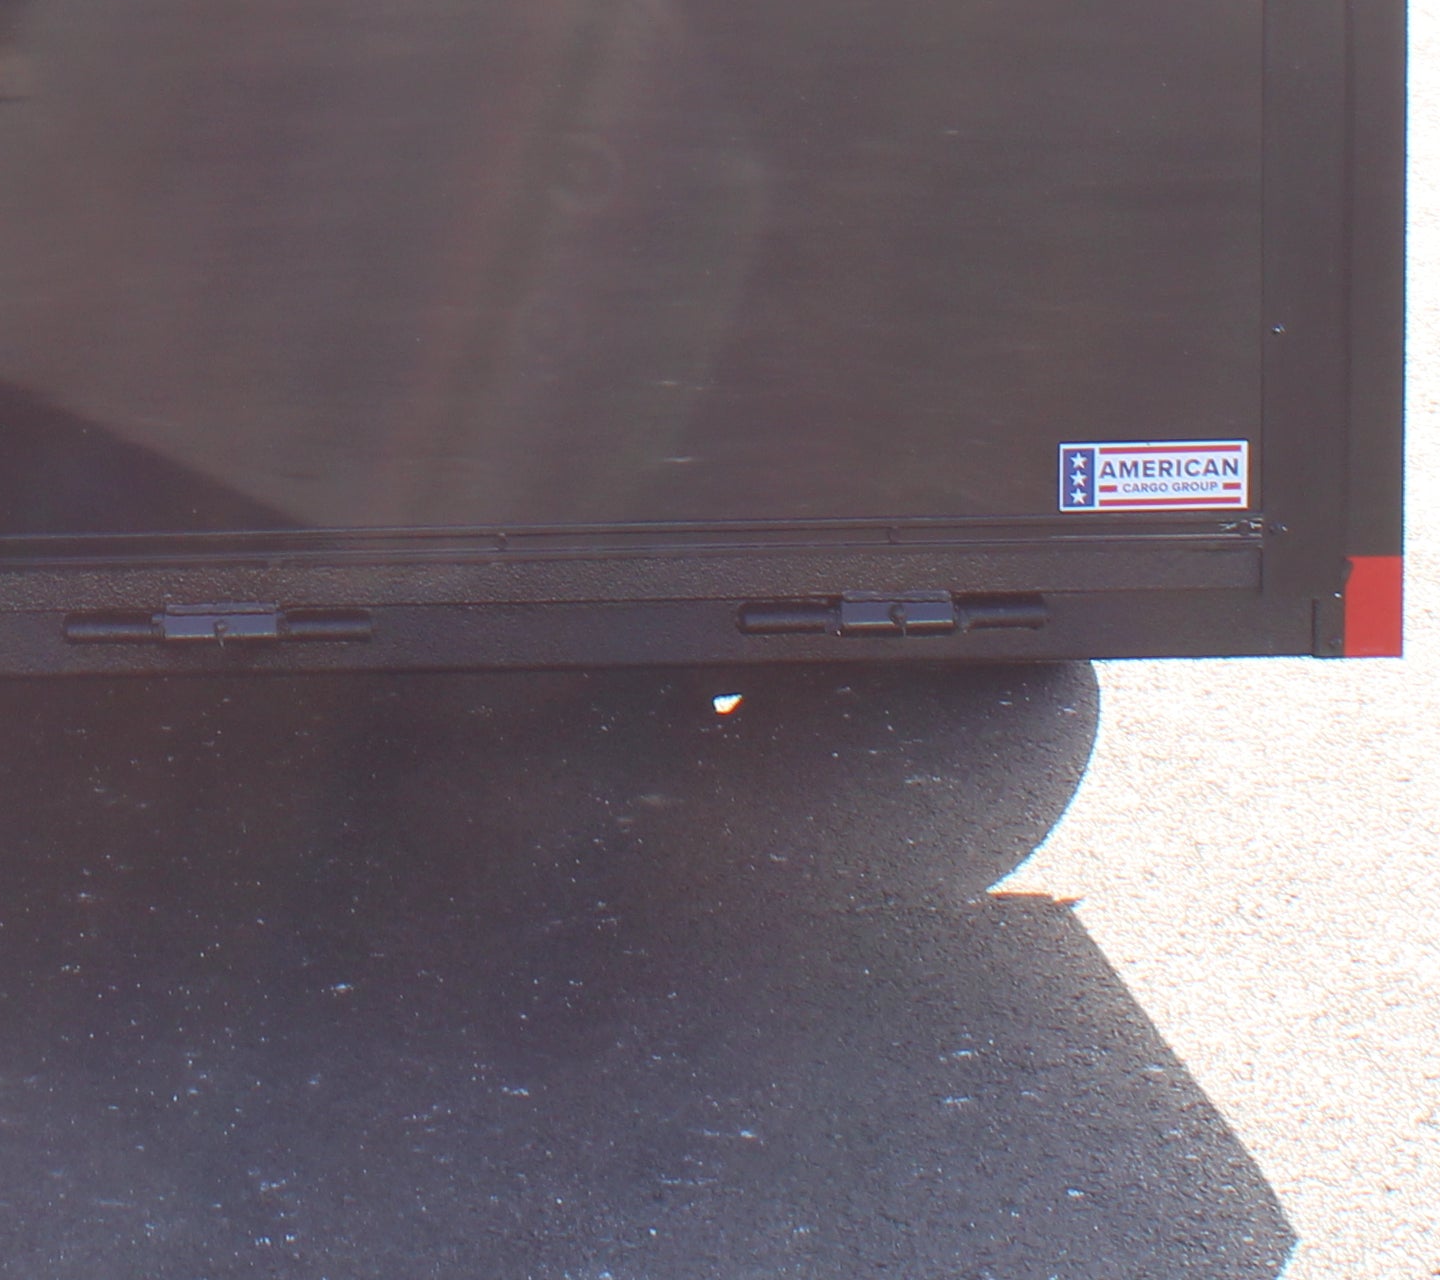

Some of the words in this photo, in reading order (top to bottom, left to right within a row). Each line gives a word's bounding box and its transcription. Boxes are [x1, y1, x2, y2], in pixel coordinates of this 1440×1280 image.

[1099, 457, 1239, 479] AMERICAN
[1123, 482, 1169, 493] CARGO
[1172, 481, 1218, 492] GROUP
